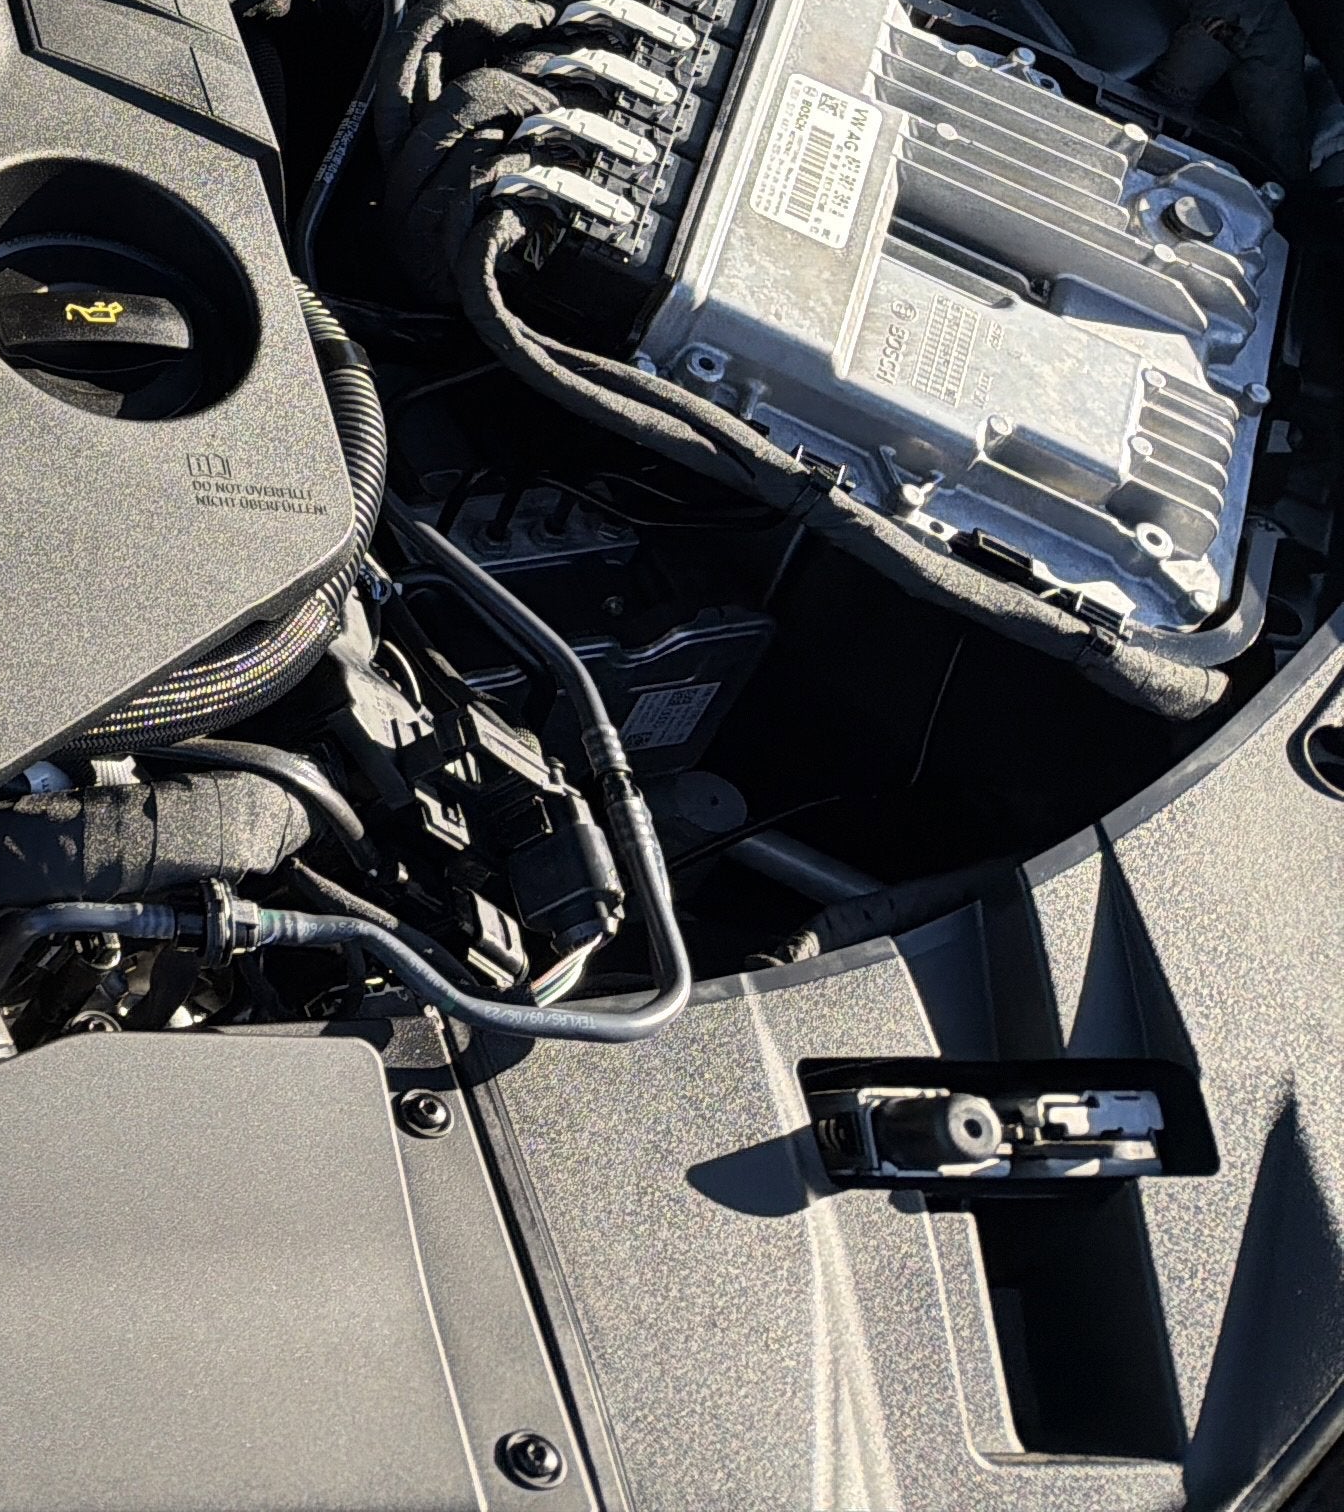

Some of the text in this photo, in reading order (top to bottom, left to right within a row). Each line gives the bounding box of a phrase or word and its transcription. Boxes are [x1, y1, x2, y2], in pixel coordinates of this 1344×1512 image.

[794, 99, 813, 132] BOSCH
[848, 106, 869, 132] VW
[842, 130, 862, 153] AG
[872, 324, 911, 385] BOSCH
[192, 481, 211, 491] DO
[215, 483, 243, 494] NOT
[195, 495, 236, 507] NICHT
